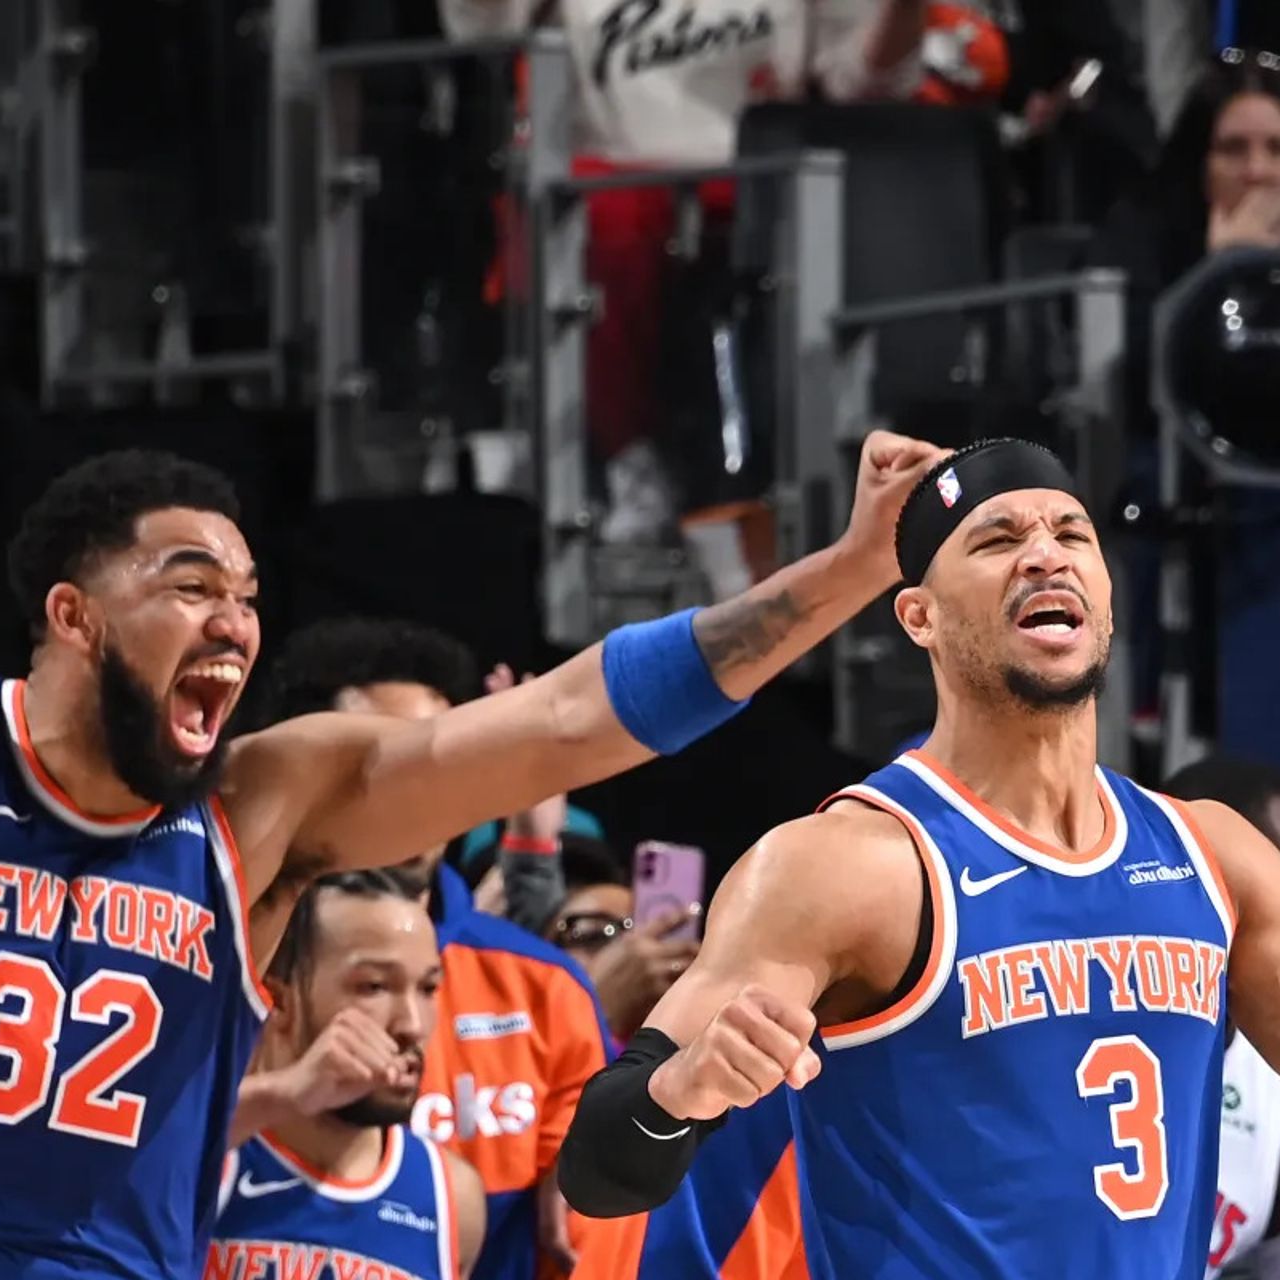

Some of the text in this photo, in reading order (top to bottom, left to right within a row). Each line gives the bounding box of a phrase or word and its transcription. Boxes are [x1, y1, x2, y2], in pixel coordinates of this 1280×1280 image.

[70, 875, 216, 984] YORK
[956, 934, 1227, 1039] NEW YORK
[1076, 1034, 1169, 1221] 3
